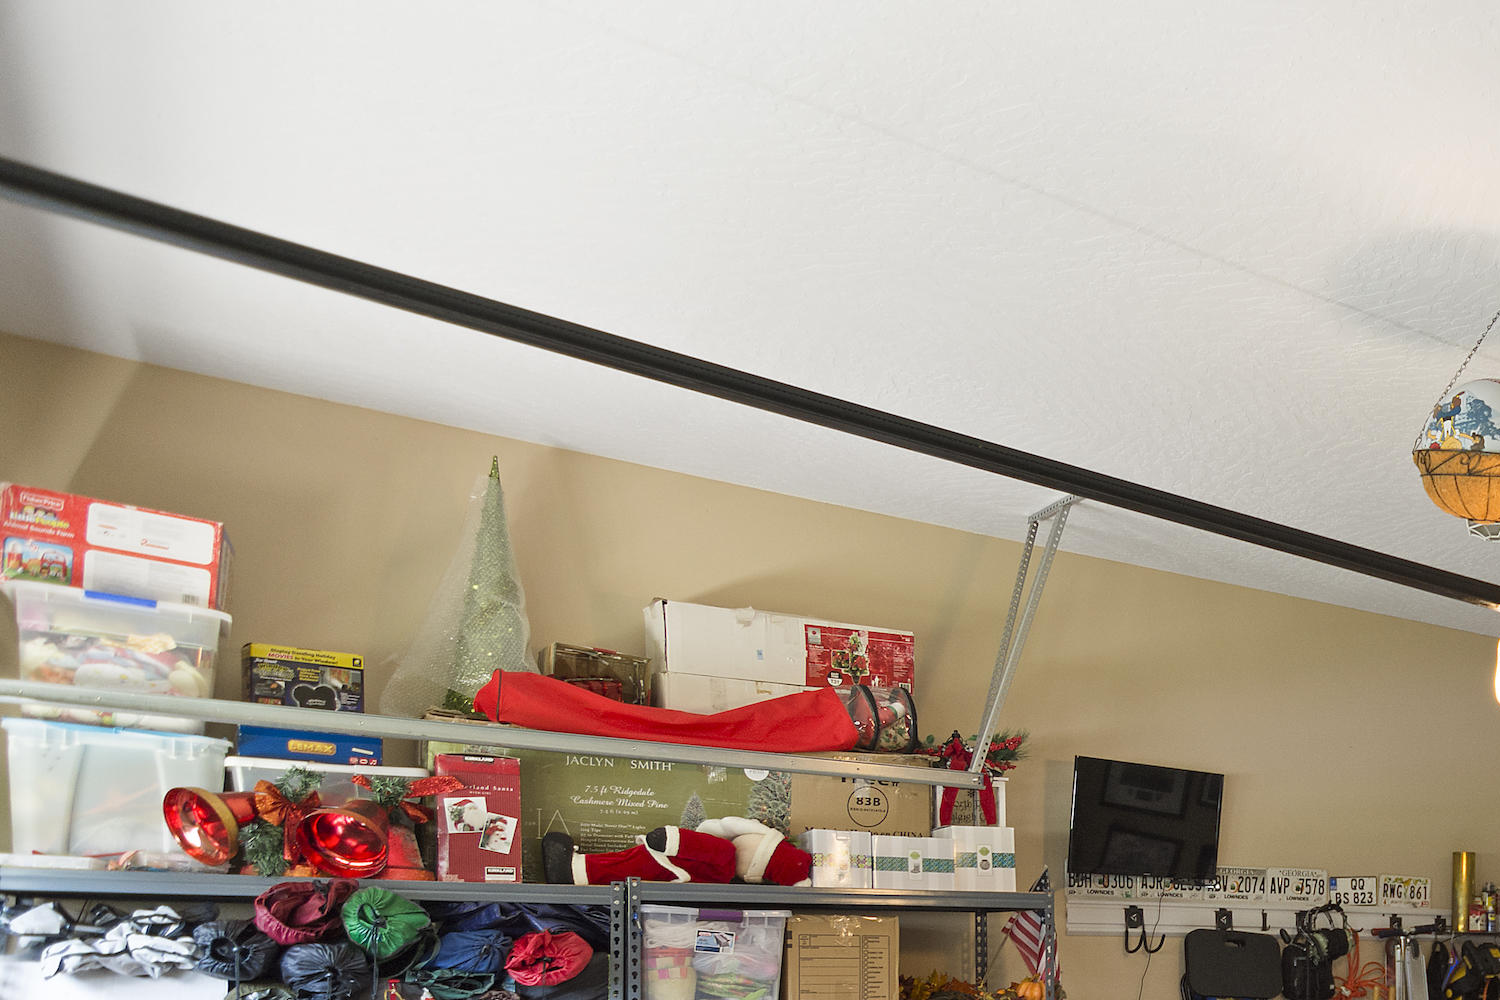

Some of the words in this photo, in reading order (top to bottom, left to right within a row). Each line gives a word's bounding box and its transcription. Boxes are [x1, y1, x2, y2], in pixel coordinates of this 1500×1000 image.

[566, 755, 614, 767] JACLYN
[630, 760, 672, 771] SMITH
[585, 785, 598, 793] 7.5
[600, 785, 608, 795] ft
[609, 785, 655, 797] Ridgedale
[570, 795, 614, 806] Cashmere
[615, 798, 645, 808] Mixed
[647, 800, 669, 809] Pine
[1281, 869, 1316, 877] GEORGIA
[1239, 876, 1265, 894] 2074
[1270, 877, 1290, 894] AVP
[1297, 878, 1325, 896] 7578
[1350, 878, 1365, 890] QQ
[1353, 891, 1373, 904] 823
[1382, 883, 1403, 899] RWG
[1409, 885, 1428, 900] 861
